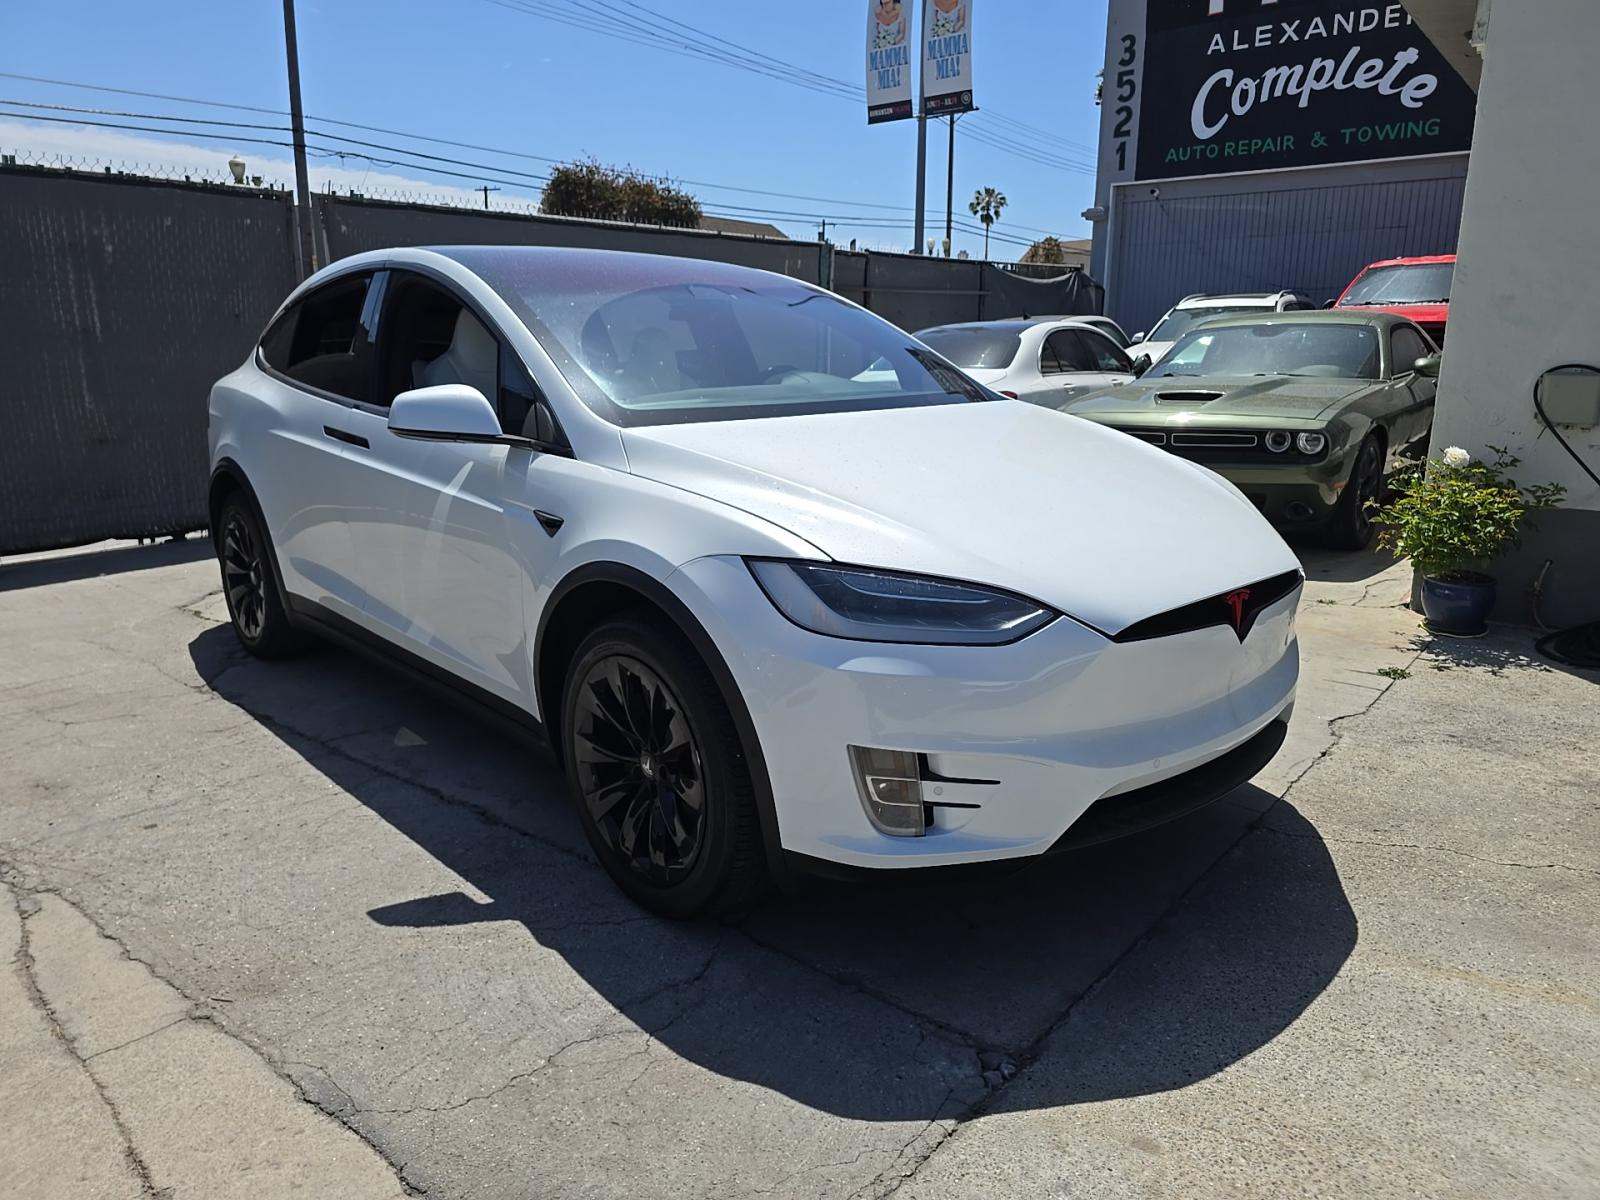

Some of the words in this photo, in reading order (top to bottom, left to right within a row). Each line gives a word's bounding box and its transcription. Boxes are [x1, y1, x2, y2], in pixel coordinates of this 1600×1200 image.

[869, 45, 908, 71] MAMMA
[928, 32, 969, 61] MAMMA
[878, 67, 901, 90] MIA!
[936, 55, 961, 80] MIA!
[1113, 34, 1136, 171] 3521
[1191, 45, 1438, 140] Complete
[1165, 145, 1219, 163] AUTO
[1224, 134, 1295, 157] REPAIR
[1310, 131, 1329, 149] &
[1340, 118, 1441, 145] TOWING
